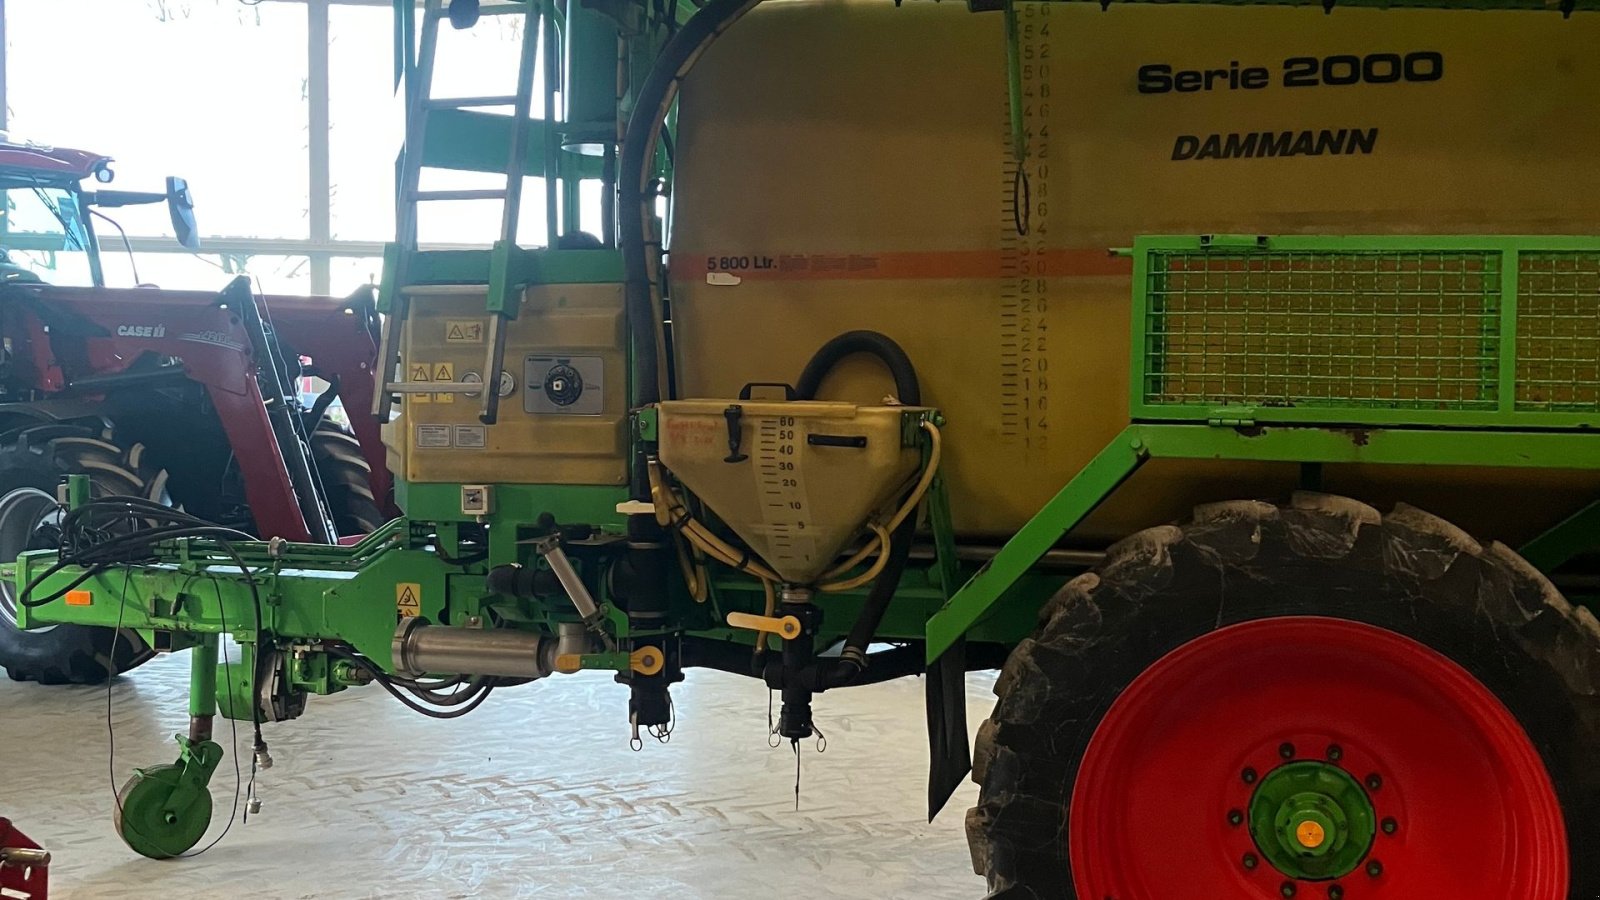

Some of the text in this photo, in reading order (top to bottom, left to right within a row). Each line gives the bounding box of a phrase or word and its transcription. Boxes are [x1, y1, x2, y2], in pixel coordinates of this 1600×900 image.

[1137, 51, 1444, 95] Serie 2000
[1171, 127, 1379, 161] DAMMANN
[719, 256, 750, 270] 800
[753, 255, 778, 269] Ltr.
[117, 325, 153, 337] CASE
[779, 430, 794, 440] 50
[779, 444, 794, 456] 40
[779, 462, 794, 471] 30
[782, 479, 797, 487] 20
[789, 502, 801, 510] 10
[798, 521, 805, 529] 5
